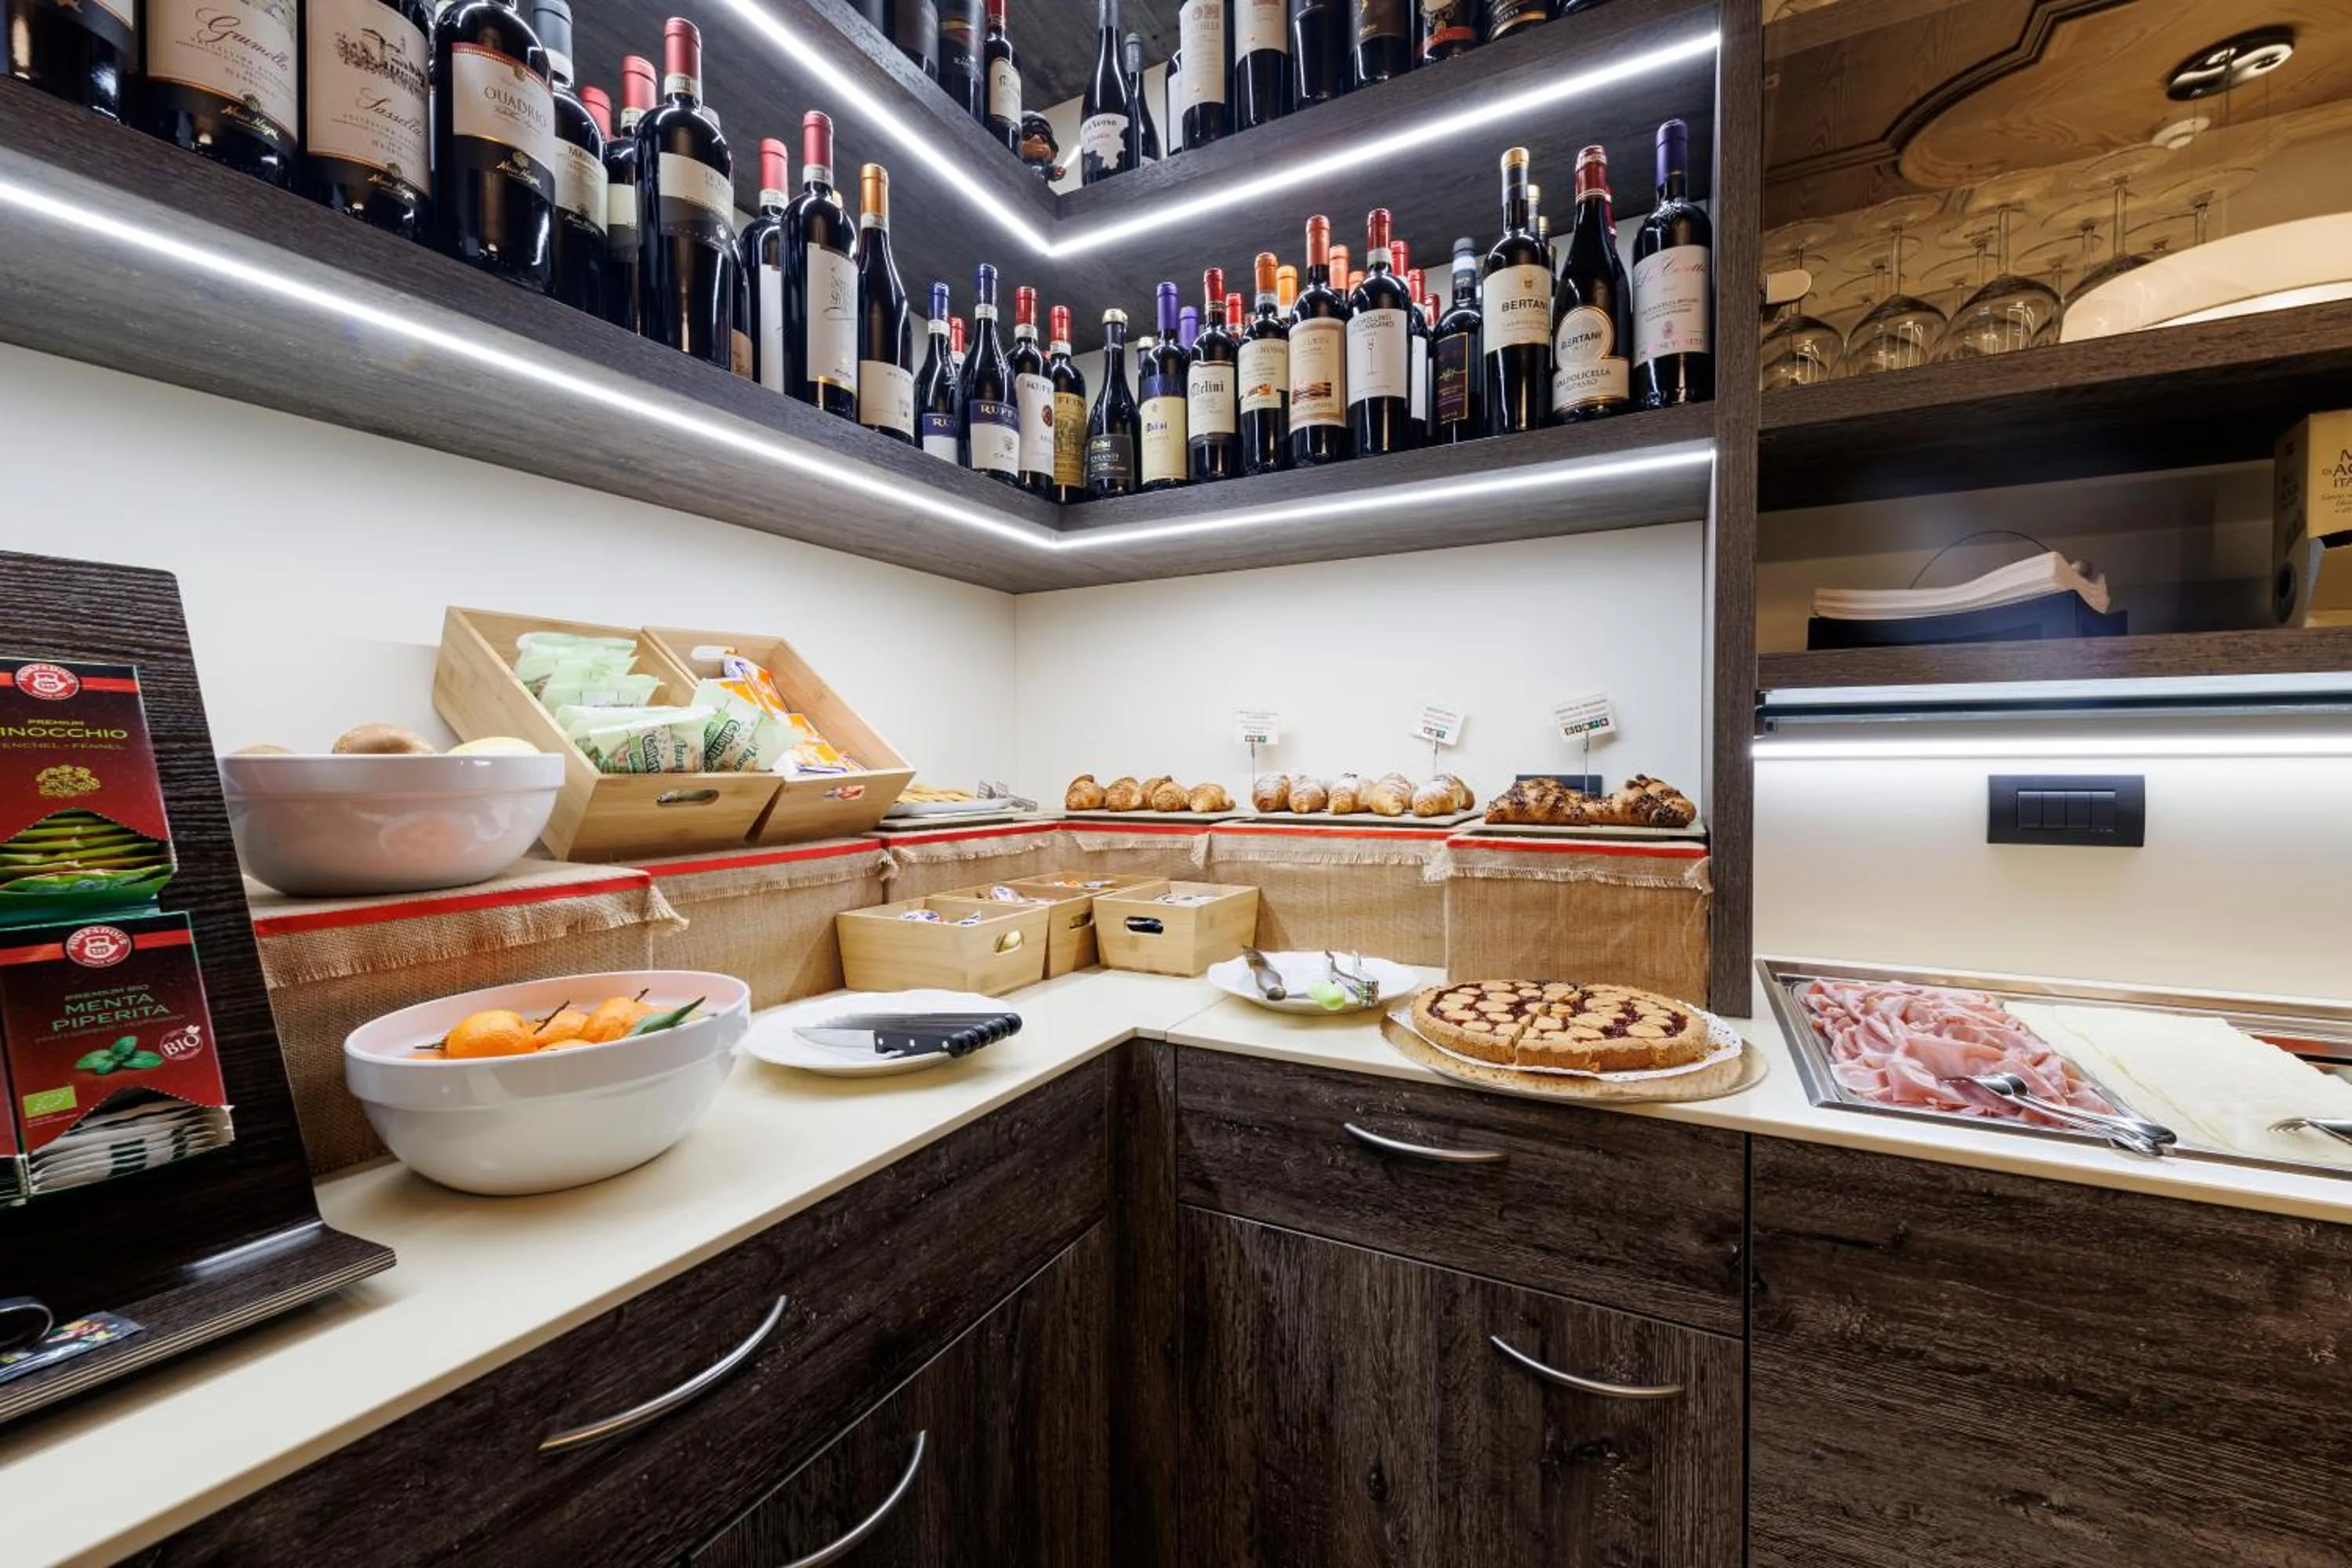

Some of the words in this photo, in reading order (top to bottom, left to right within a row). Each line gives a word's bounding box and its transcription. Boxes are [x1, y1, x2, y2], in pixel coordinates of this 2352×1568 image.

[1501, 298, 1550, 313] BERTANI
[64, 993, 154, 1015] MENTA
[51, 1004, 171, 1033] PIPERITA
[162, 1033, 201, 1057] BIO
